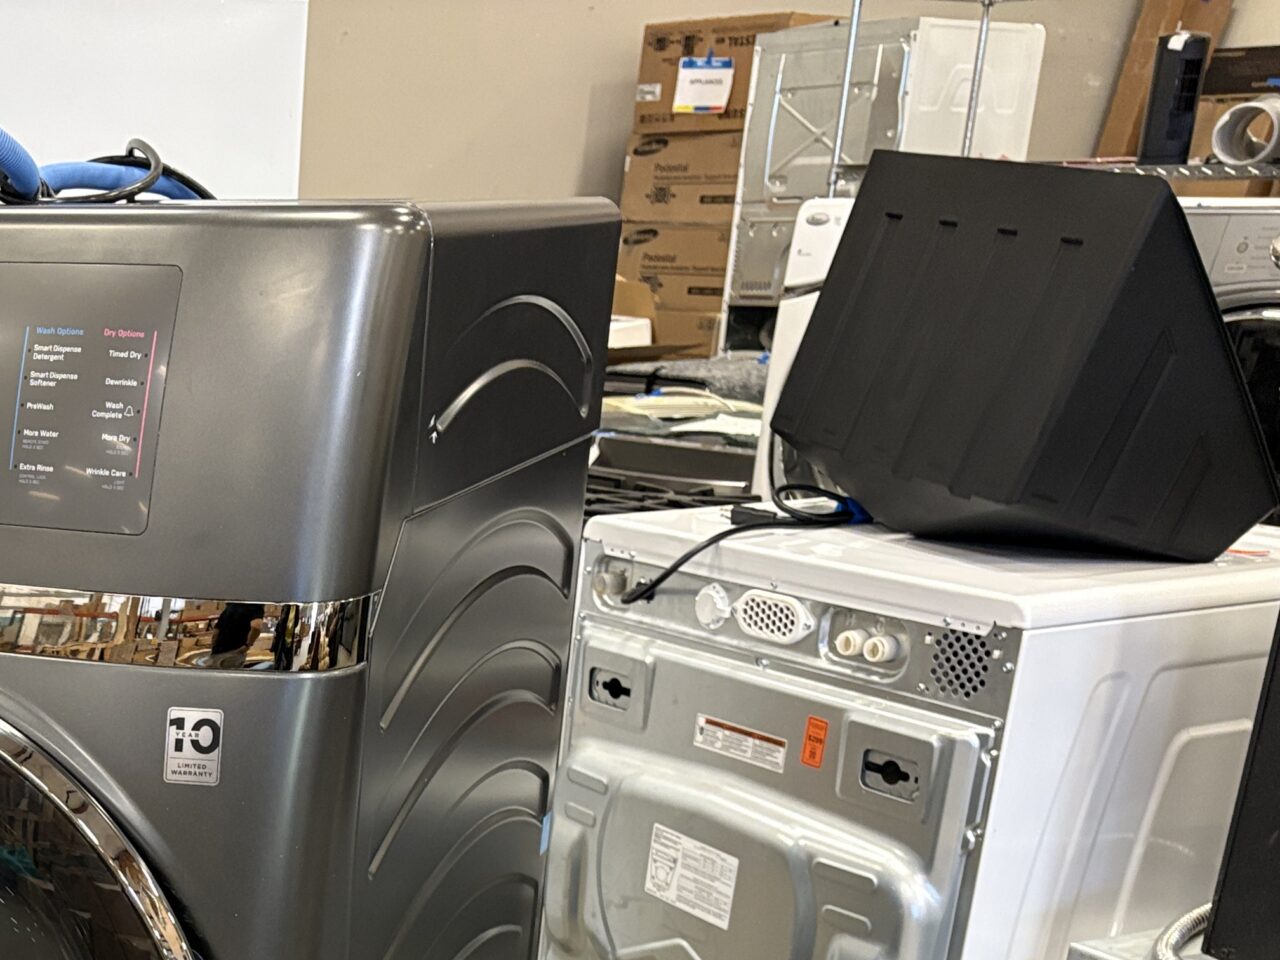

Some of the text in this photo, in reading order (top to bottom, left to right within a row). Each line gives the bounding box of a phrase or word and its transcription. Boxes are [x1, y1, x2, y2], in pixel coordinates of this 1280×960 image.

[36, 327, 84, 336] Wash Options
[103, 328, 145, 339] Dry Options
[33, 344, 82, 354] Smart Dispense
[32, 353, 64, 362] Detergent
[109, 350, 142, 360] Timed Dry
[30, 371, 78, 381] Smart Dispense
[29, 379, 57, 387] Softener
[105, 378, 137, 387] Dewrinkle
[26, 402, 54, 411] PreWash
[91, 410, 122, 419] Complete
[23, 429, 59, 438] More Water
[101, 433, 131, 443] More Dry
[19, 463, 54, 472] Extra Rinse
[86, 467, 127, 477] Wrinkle Care
[169, 717, 220, 755] 10
[171, 769, 212, 777] WARRANTY
